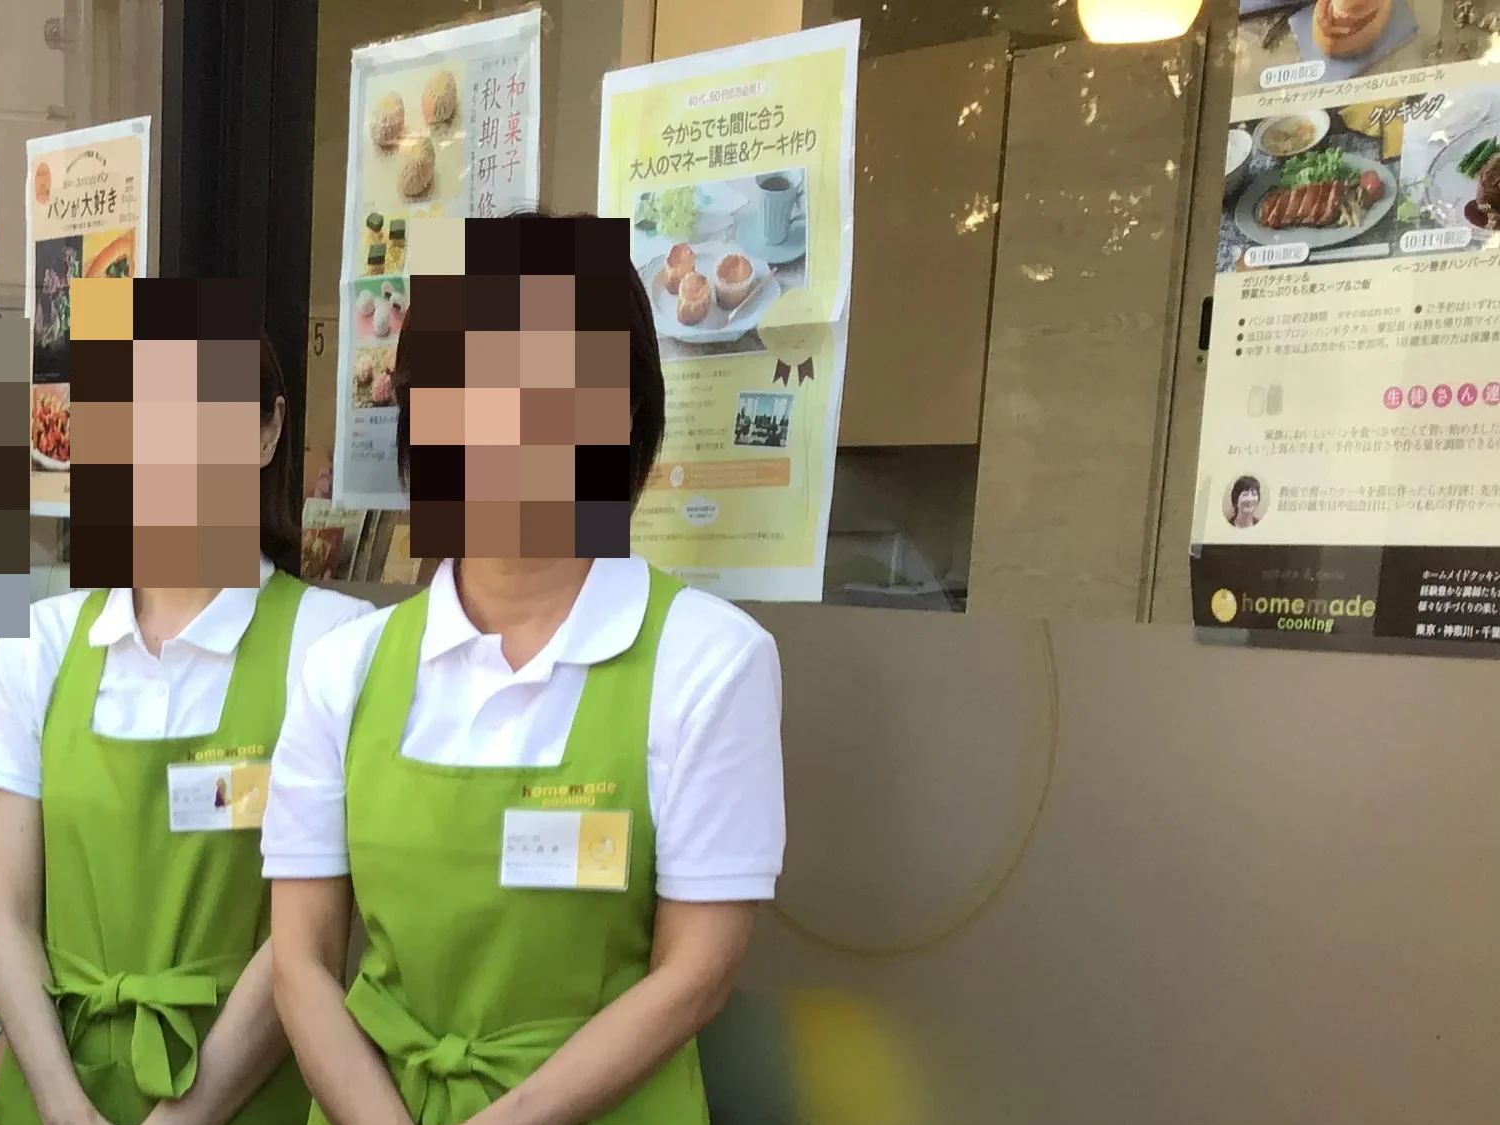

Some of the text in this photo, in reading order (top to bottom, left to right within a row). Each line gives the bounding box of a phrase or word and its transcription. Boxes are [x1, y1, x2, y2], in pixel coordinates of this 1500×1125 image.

[661, 104, 785, 147] 今からでも間に合う
[1368, 94, 1446, 126] クッキング
[501, 72, 526, 183] 和菓子
[477, 77, 502, 218] 秋期研修
[629, 127, 818, 181] 大人のマネー講座&ケーキ作り
[47, 188, 118, 220] パンが大好き
[313, 322, 325, 356] 5
[1241, 592, 1377, 618] homemade
[1277, 615, 1335, 633] cooking
[522, 780, 617, 798] homemade
